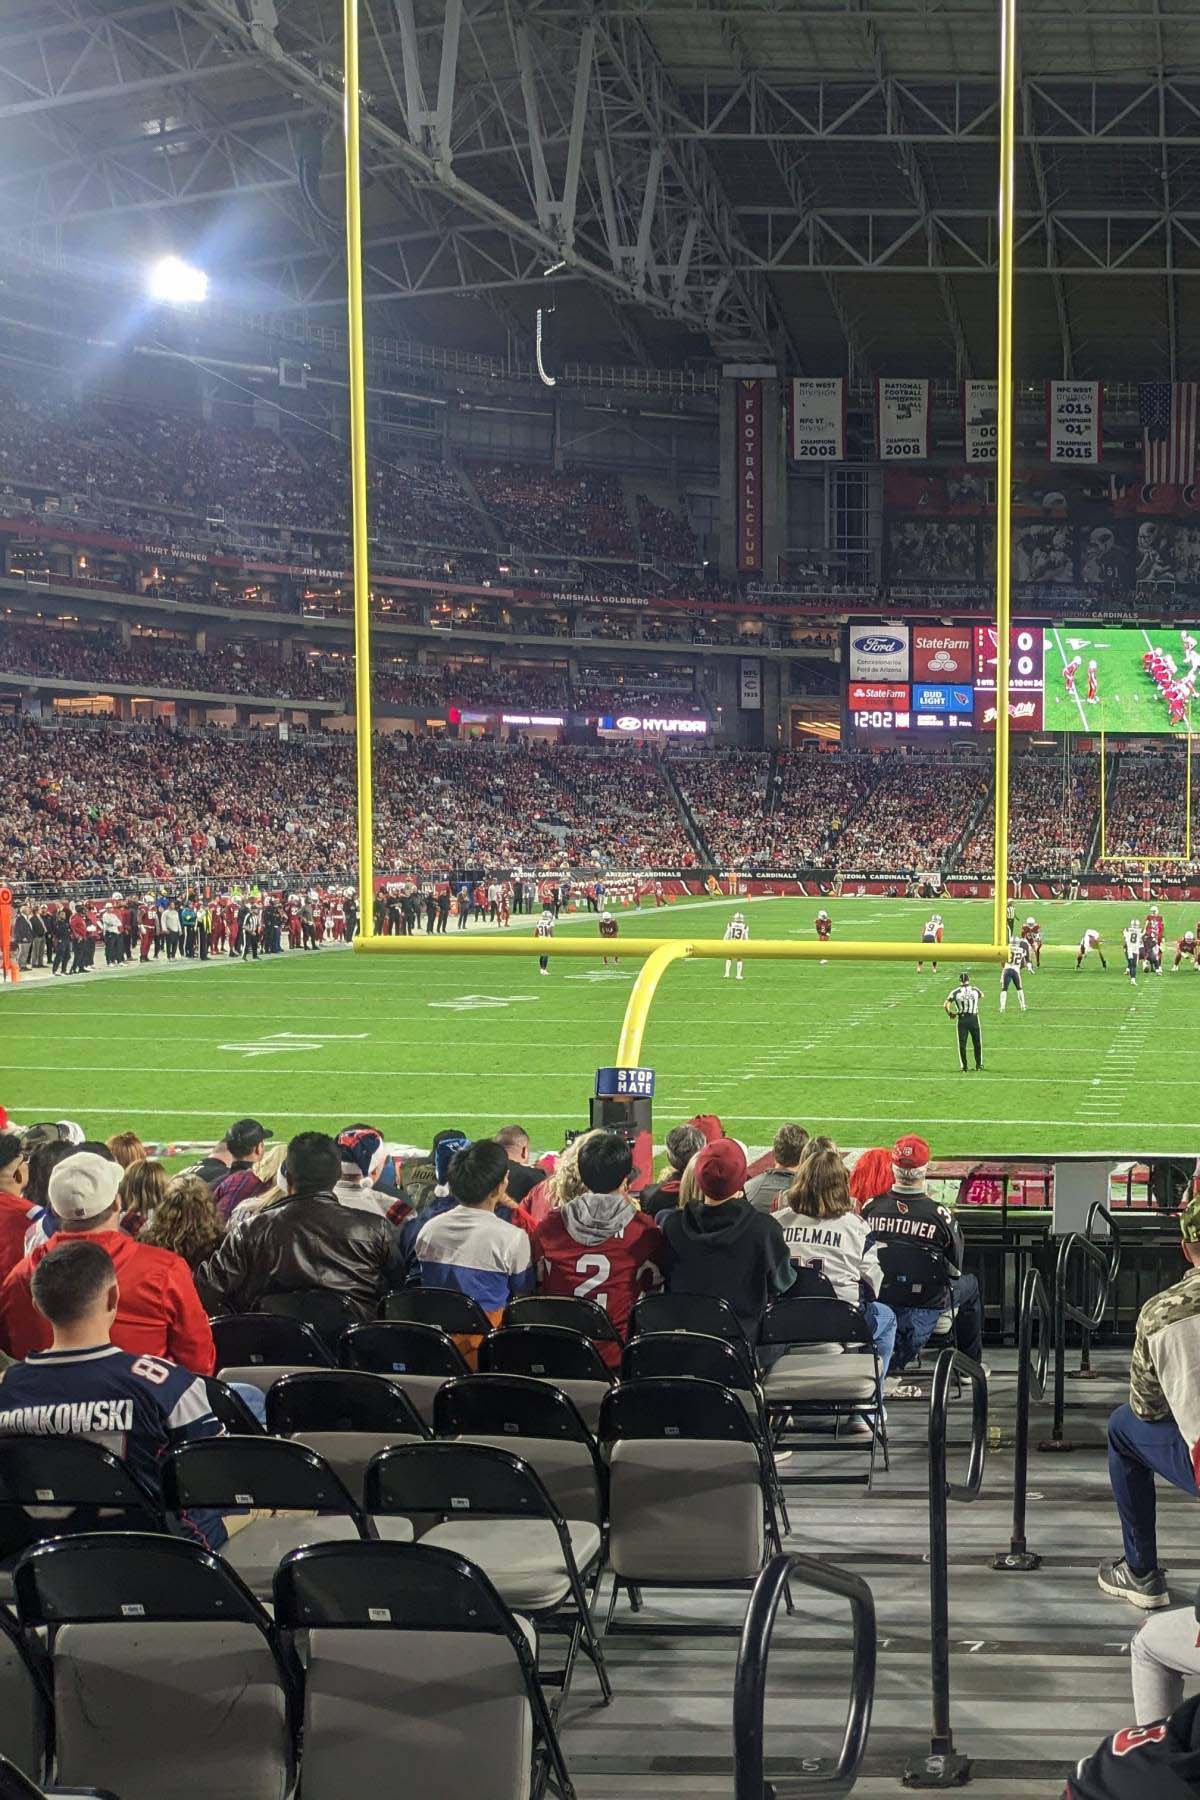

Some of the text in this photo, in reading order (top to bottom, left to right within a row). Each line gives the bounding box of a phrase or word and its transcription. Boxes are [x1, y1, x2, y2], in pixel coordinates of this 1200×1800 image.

[1057, 403, 1092, 414] 2015
[799, 445, 837, 456] 2008
[885, 444, 920, 455] 2008
[971, 447, 999, 458] 200
[1056, 447, 1092, 458] 2015
[744, 400, 756, 567] FOOTBALL CLUB
[145, 546, 208, 562] KURT WARNER
[302, 568, 318, 577] JIM
[319, 569, 344, 578] HART
[552, 593, 600, 602] MARSHALL
[602, 596, 649, 605] GOLDBERG
[1091, 611, 1139, 619] CARDINALS
[863, 637, 896, 652] Ford
[1017, 631, 1033, 651] 0
[1017, 656, 1033, 675] 0
[919, 697, 946, 705] LIGHT
[642, 718, 707, 732] HYUNDAI
[854, 711, 893, 728] 12:02
[538, 925, 548, 937] 31
[731, 927, 743, 940] 13
[927, 923, 935, 932] 9
[1130, 932, 1138, 944] 8
[617, 1070, 653, 1082] STOP
[617, 1082, 652, 1094] HATE
[868, 1216, 937, 1240] HIGHTOWER
[783, 1226, 843, 1249] DELMAN
[573, 1253, 611, 1310] 2
[1114, 1569, 1127, 1585] N
